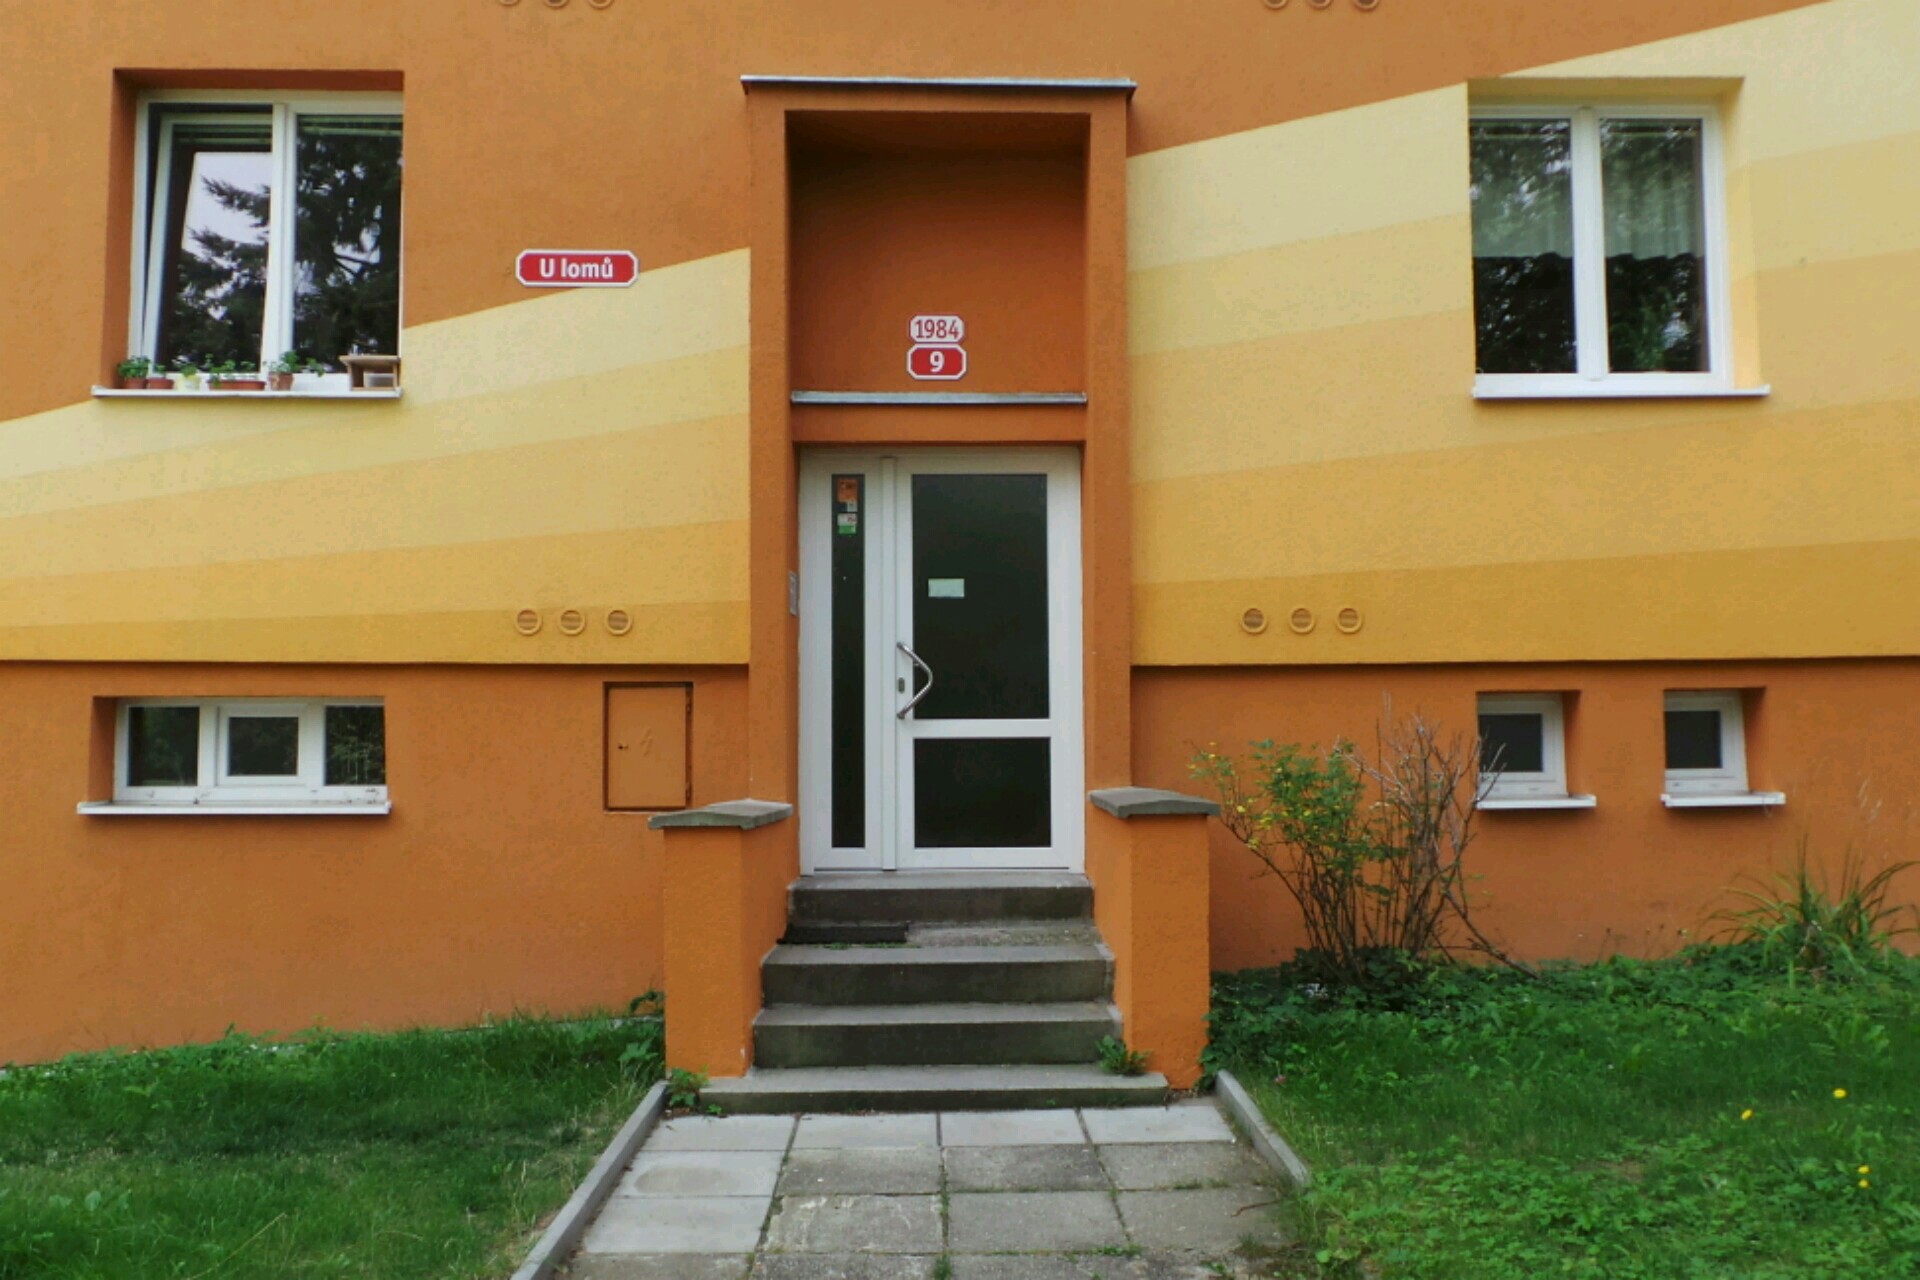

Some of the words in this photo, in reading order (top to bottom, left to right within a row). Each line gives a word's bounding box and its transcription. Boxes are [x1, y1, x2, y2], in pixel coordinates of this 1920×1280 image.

[540, 258, 555, 278] U
[561, 256, 613, 279] lomů
[915, 319, 960, 339] 1984
[930, 350, 945, 373] 9
